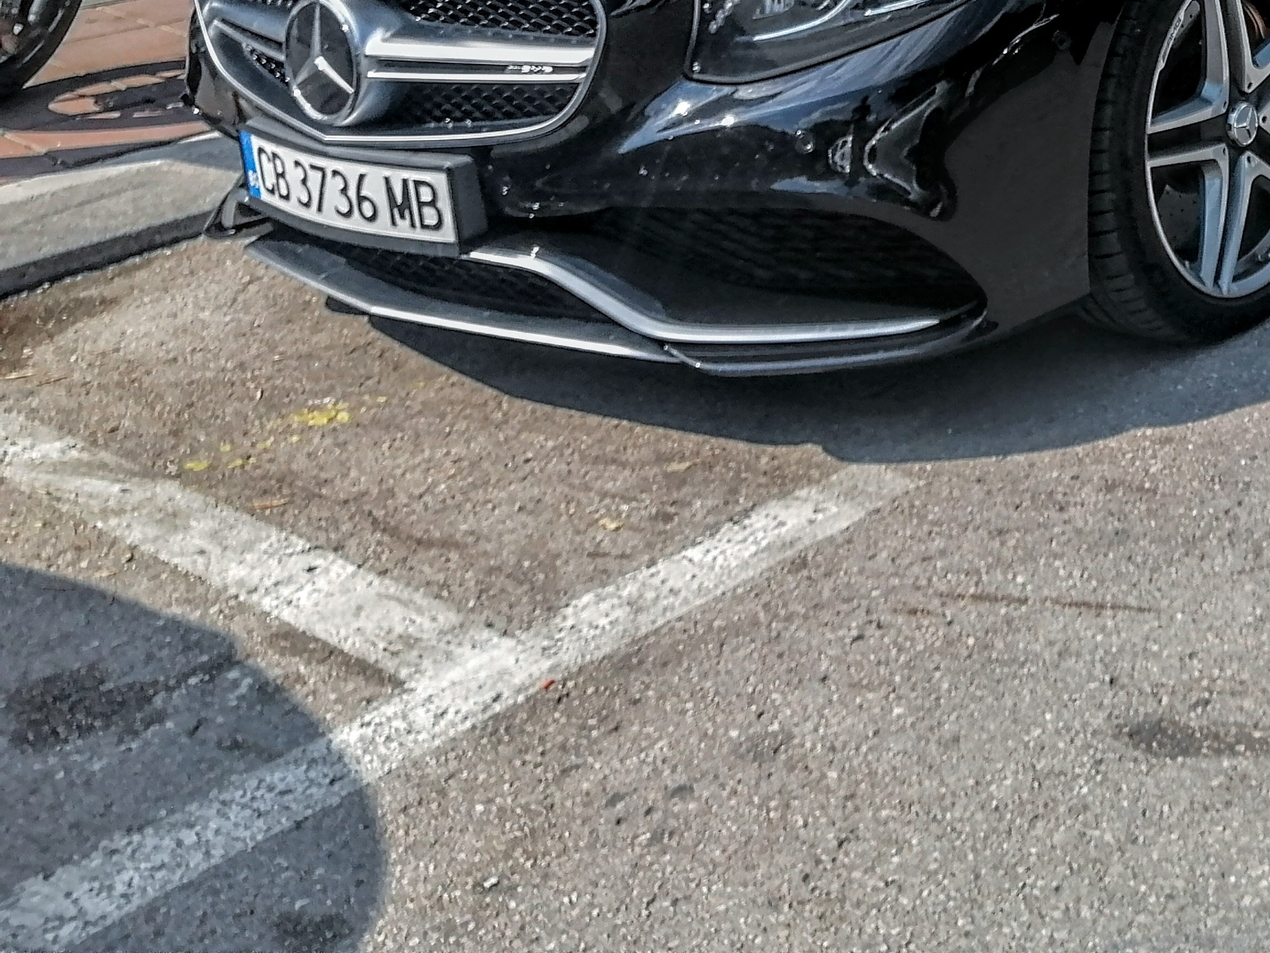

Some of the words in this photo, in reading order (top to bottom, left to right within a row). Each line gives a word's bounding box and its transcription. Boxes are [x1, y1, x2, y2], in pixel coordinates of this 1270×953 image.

[257, 146, 290, 201] CB
[294, 159, 377, 223] 3736
[384, 175, 443, 231] MB
